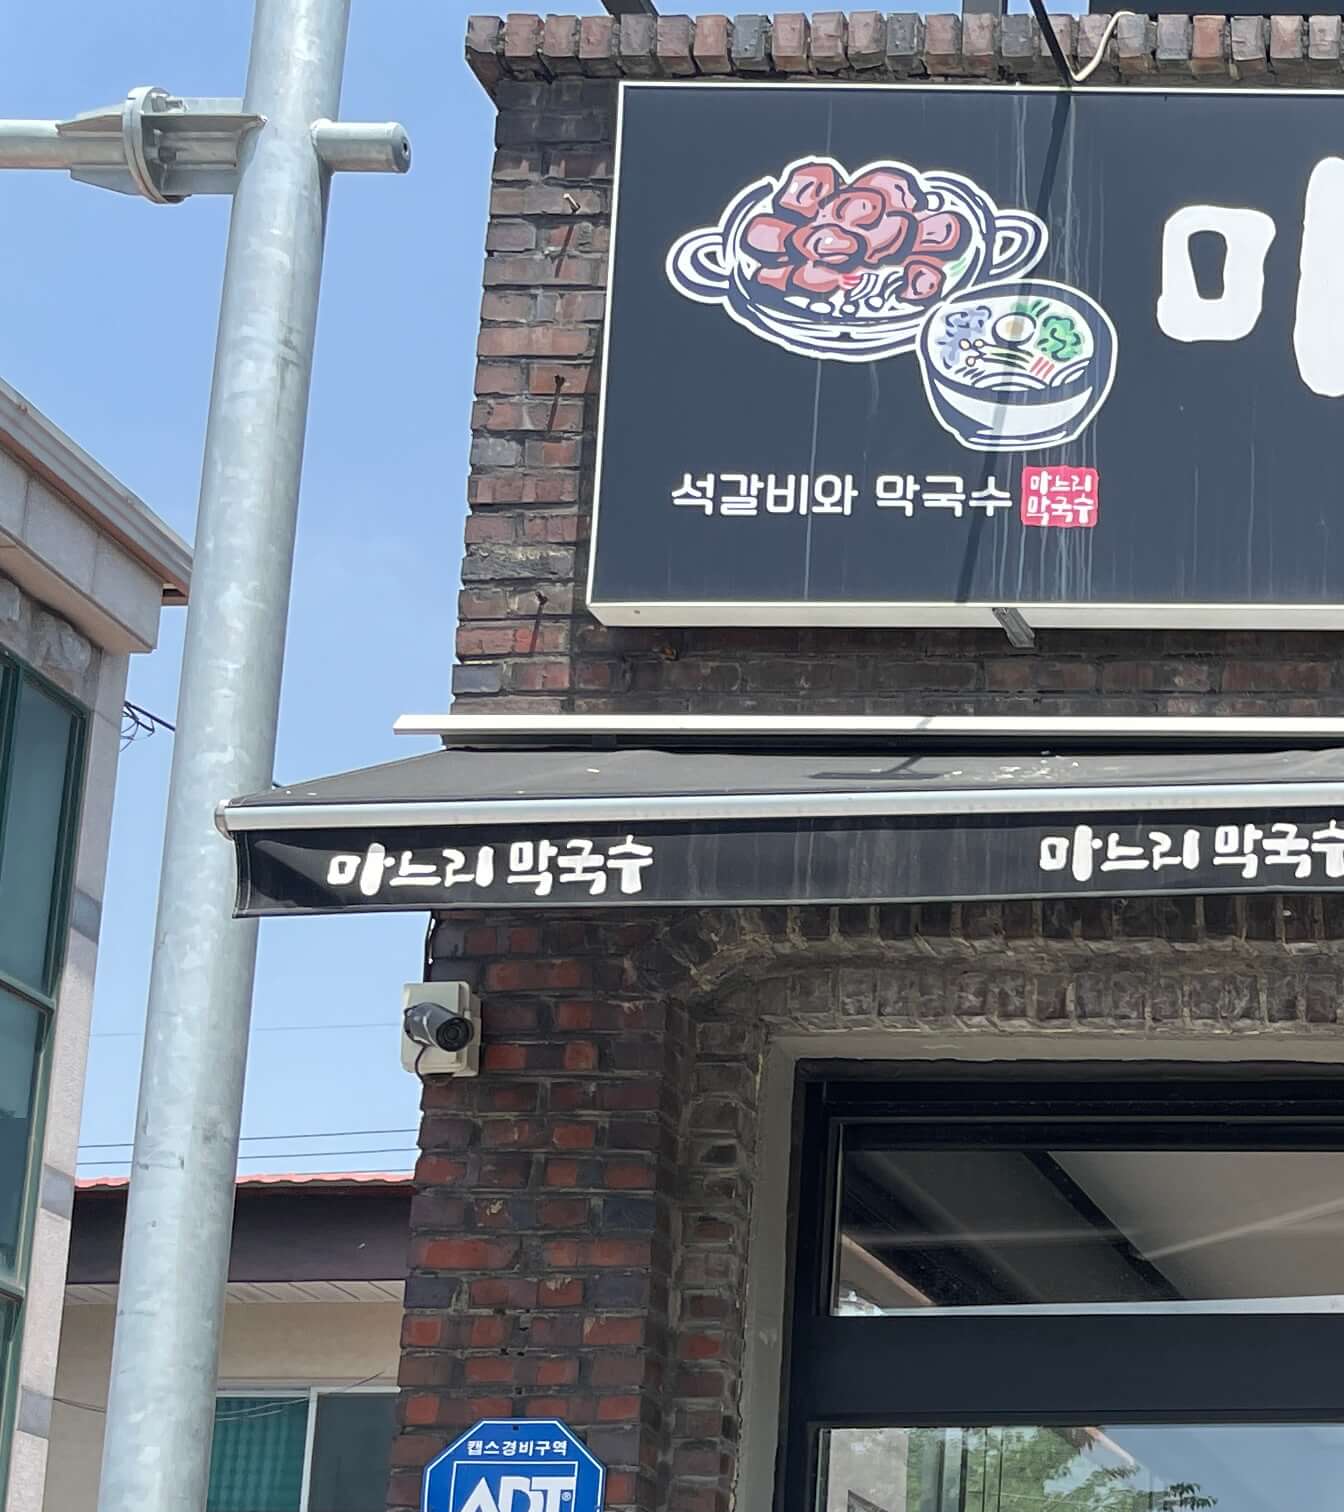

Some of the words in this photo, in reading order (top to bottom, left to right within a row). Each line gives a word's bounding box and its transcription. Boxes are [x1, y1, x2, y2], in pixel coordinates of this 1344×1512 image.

[670, 471, 858, 517] 석갈비와
[875, 473, 1013, 520] 막국수
[1030, 470, 1092, 496] 마느리
[1026, 493, 1095, 526] 막국수
[327, 840, 494, 896] 마느리
[507, 833, 654, 896] 막국수
[1040, 824, 1200, 883] 마느리
